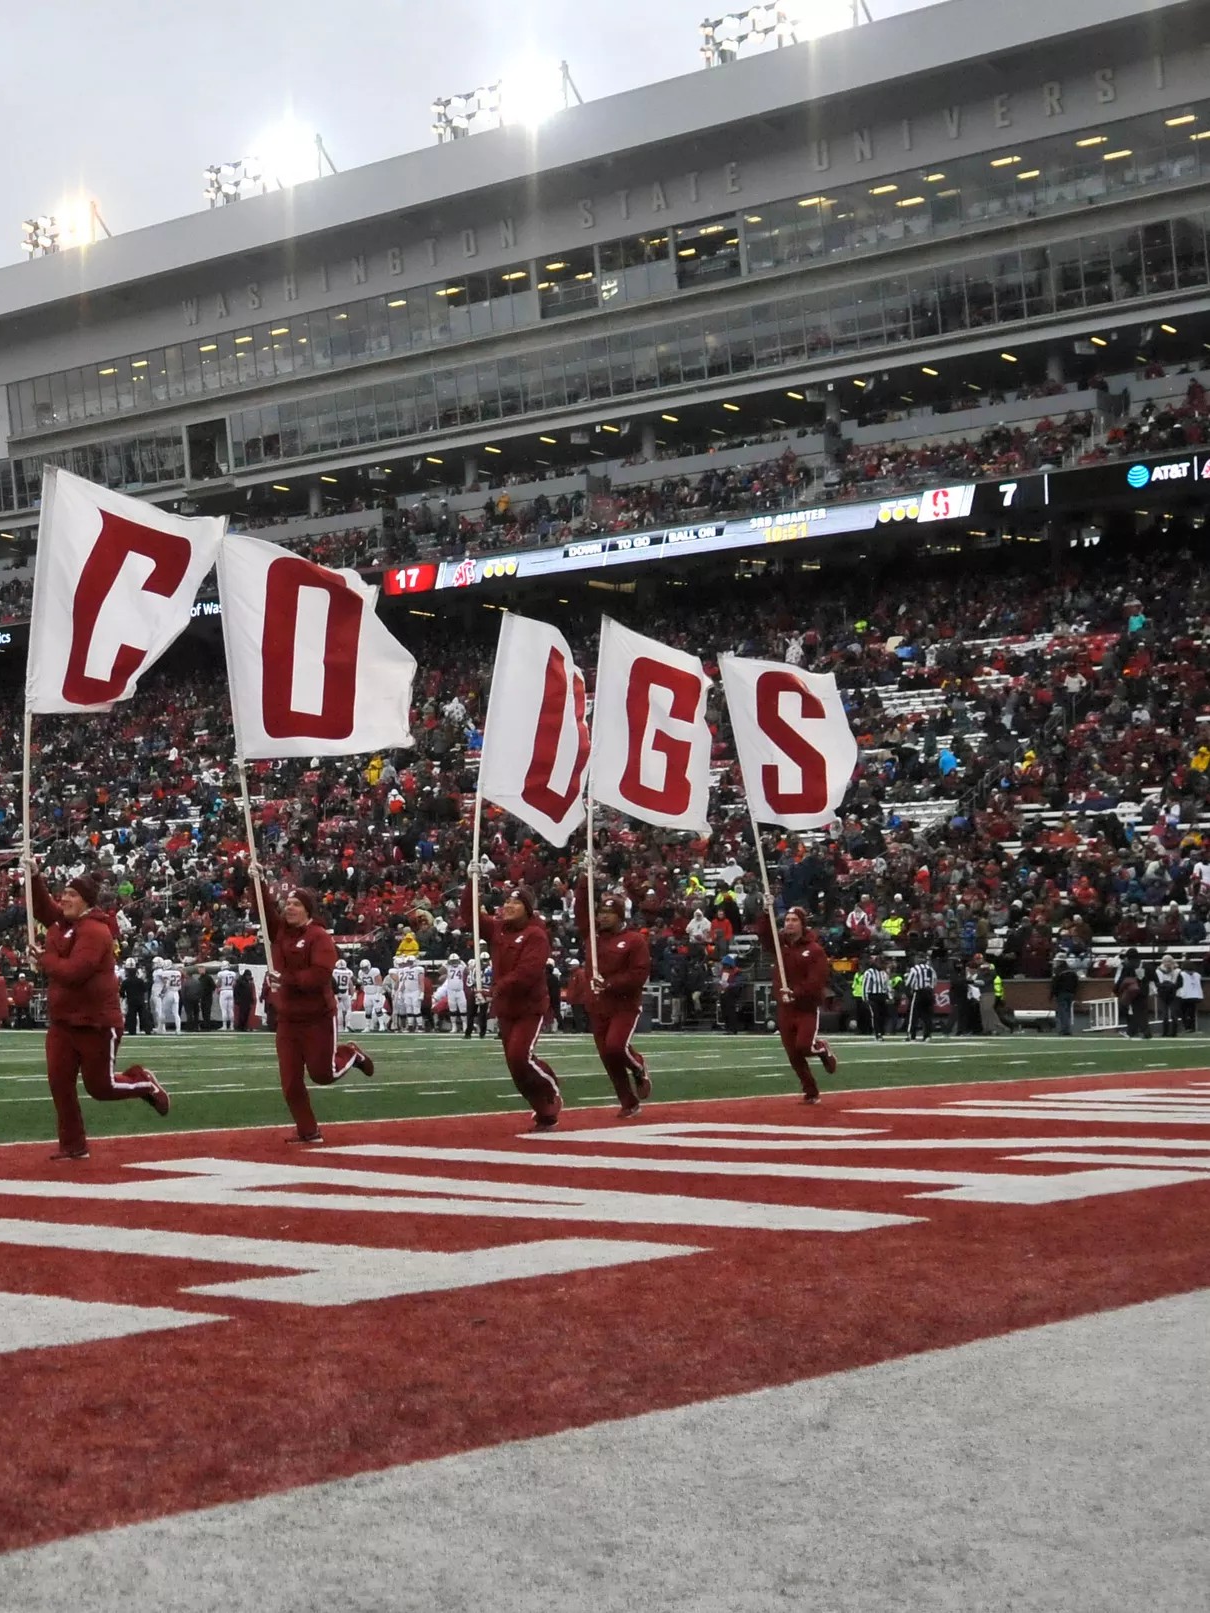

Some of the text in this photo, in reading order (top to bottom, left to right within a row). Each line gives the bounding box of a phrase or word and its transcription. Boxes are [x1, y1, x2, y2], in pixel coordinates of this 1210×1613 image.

[182, 217, 517, 327] WASHINGTON
[578, 161, 742, 230] STATE
[1150, 461, 1191, 482] AT&T
[998, 482, 1018, 507] 7
[749, 508, 827, 530] 3RD QUARTER
[616, 536, 651, 550] TO GO
[668, 526, 716, 543] BALL ON
[763, 522, 808, 543] 10:51
[568, 543, 602, 557] DOWN
[395, 568, 420, 589] 17
[61, 507, 192, 706] C
[261, 556, 365, 740] O
[618, 656, 702, 816] G
[756, 671, 829, 815] S
[169, 974, 181, 987] 22
[336, 975, 348, 986] 19
[449, 969, 462, 980] 74
